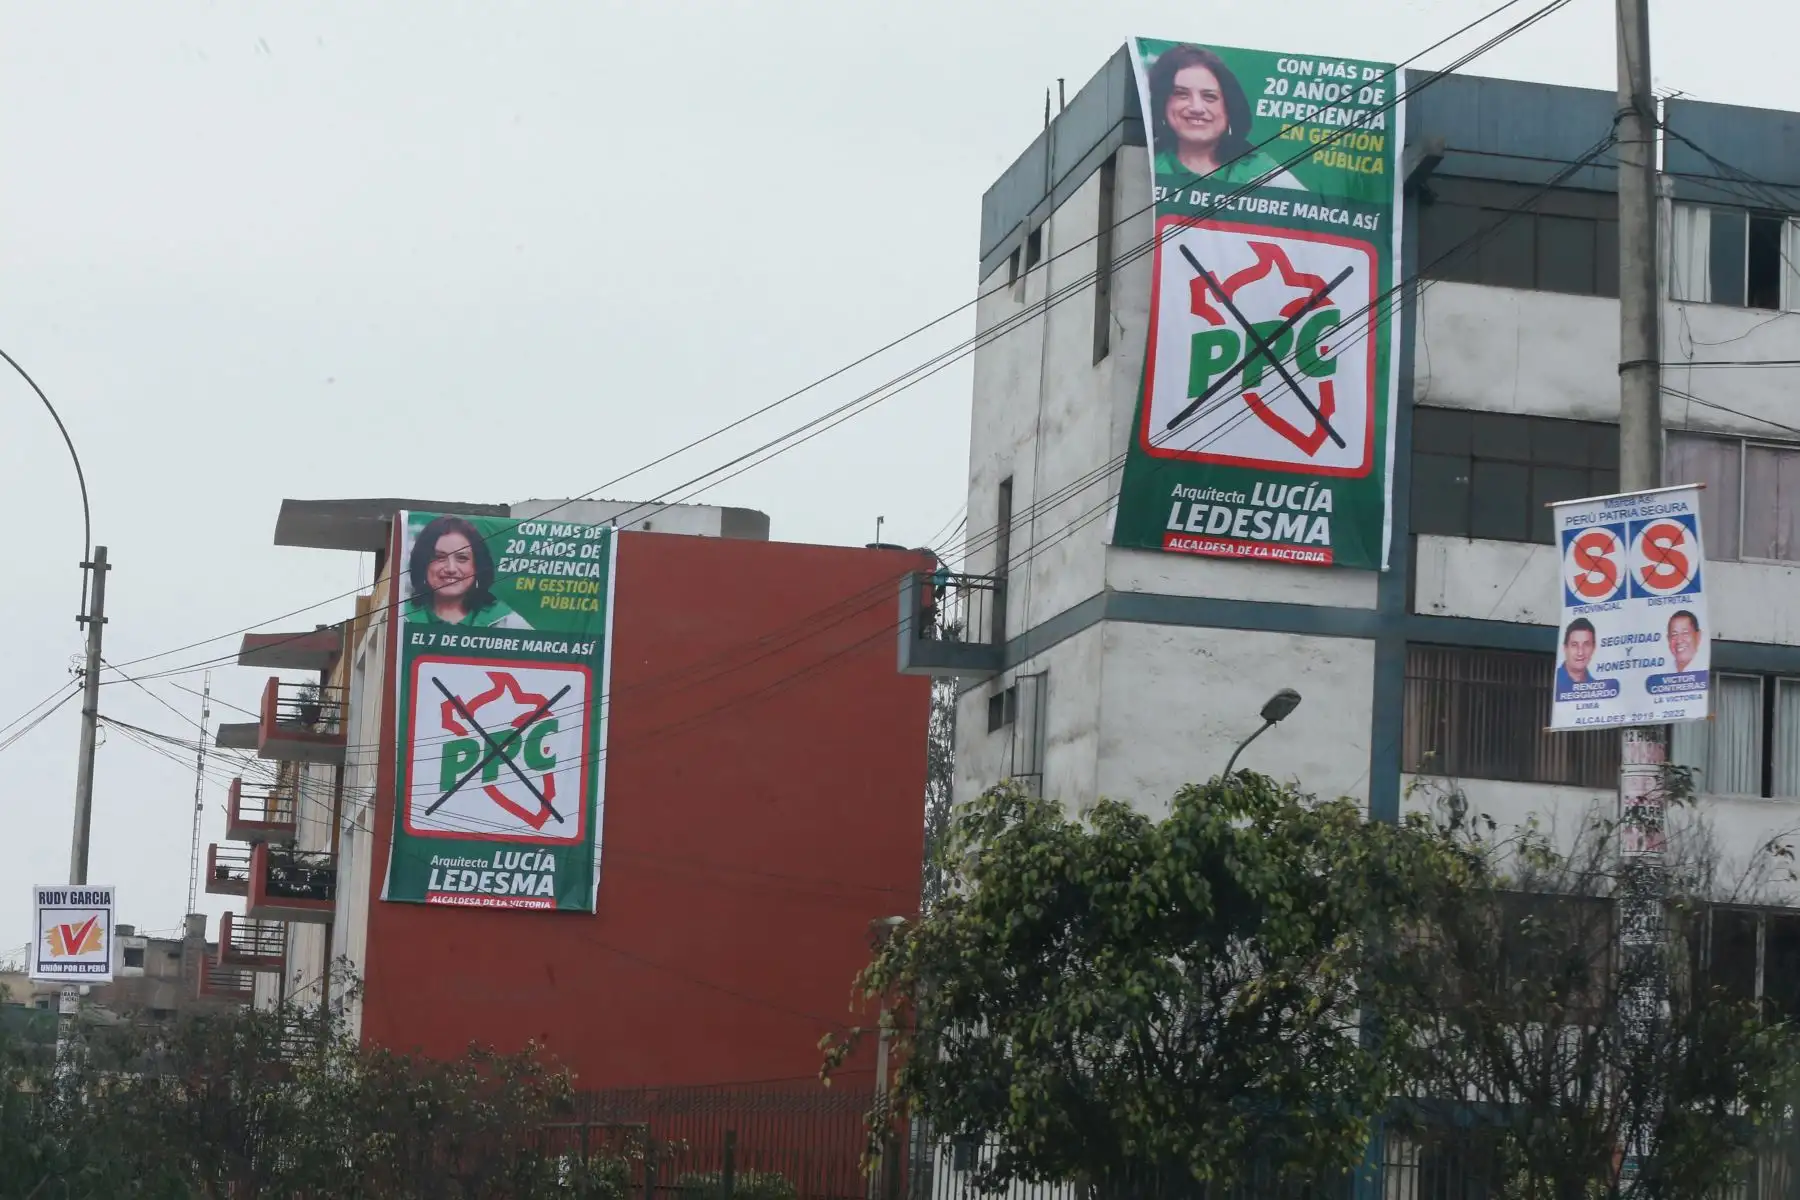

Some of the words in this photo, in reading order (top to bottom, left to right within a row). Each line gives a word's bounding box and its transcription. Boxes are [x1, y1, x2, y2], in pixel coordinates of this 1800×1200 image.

[1277, 58, 1314, 76] CON
[1318, 62, 1358, 79] MÁS
[1362, 67, 1385, 82] DE
[1264, 77, 1289, 96] 20
[1293, 79, 1353, 103] AÑOS
[1358, 87, 1385, 106] DE
[1256, 98, 1386, 130] EXPERIENCIA
[1280, 124, 1305, 141] EN
[1309, 130, 1384, 152] GESTIÓN
[1313, 149, 1384, 174] PÚBLICA
[1155, 186, 1170, 202] EL
[1174, 188, 1183, 203] 7
[1190, 190, 1211, 208] DE
[1214, 193, 1288, 217] OCTUBRE
[1293, 202, 1350, 225] MARCA
[1352, 212, 1381, 231] ASÍ
[1187, 309, 1341, 399] PPC
[1171, 483, 1246, 504] Arquitecta
[1250, 481, 1333, 513] LUCÍA
[1166, 501, 1331, 546] LEDESMA
[1565, 511, 1597, 526] PERÚ
[1599, 508, 1639, 524] PATRIA
[1640, 502, 1689, 516] SEGURA
[517, 523, 548, 537] CON
[584, 526, 603, 539] DE
[505, 539, 526, 555] 20
[529, 538, 577, 558] AÑOS
[580, 544, 602, 559] DE
[1168, 538, 1234, 554] ALCALDESA
[1237, 545, 1252, 556] DE
[1254, 547, 1268, 557] LA
[1271, 548, 1326, 562] VICTORIA
[497, 557, 600, 578] EXPERIENCIA
[516, 577, 536, 591] EN
[538, 578, 600, 594] GESTIÓN
[540, 593, 599, 612] PÚBLICA
[1572, 602, 1623, 615] PROVINCIAL
[1648, 595, 1693, 607] DISTRITAL
[411, 632, 425, 645] EL
[428, 634, 436, 645] 7
[441, 635, 459, 647] DE
[460, 636, 519, 652] OCTUBRE
[522, 640, 569, 655] MARCA
[571, 641, 596, 656] ASÍ
[1600, 632, 1662, 647] SEGURIDAD
[1625, 647, 1633, 656] Y
[1595, 657, 1665, 672] HONESTIDAD
[1572, 682, 1606, 691] RENZO
[1651, 682, 1707, 694] CONTRERAS
[1662, 674, 1696, 684] VICTOR
[1560, 688, 1618, 700] REGGIARDO
[1574, 713, 1626, 725] ALCALDES
[440, 719, 559, 793] PPC
[430, 855, 488, 868] Arquitecta
[492, 849, 556, 872] LUCÍA
[427, 868, 555, 897] LEDESMA
[38, 891, 68, 905] RUDY
[70, 891, 111, 905] GARCIA
[431, 896, 481, 906] ALCALDESA
[483, 898, 495, 906] DE
[497, 899, 508, 907] LA
[510, 900, 551, 909] VICTORIA
[40, 963, 63, 972] UNIÓN
[63, 964, 78, 972] POR
[79, 964, 87, 972] EL
[87, 964, 106, 972] PERÚ
